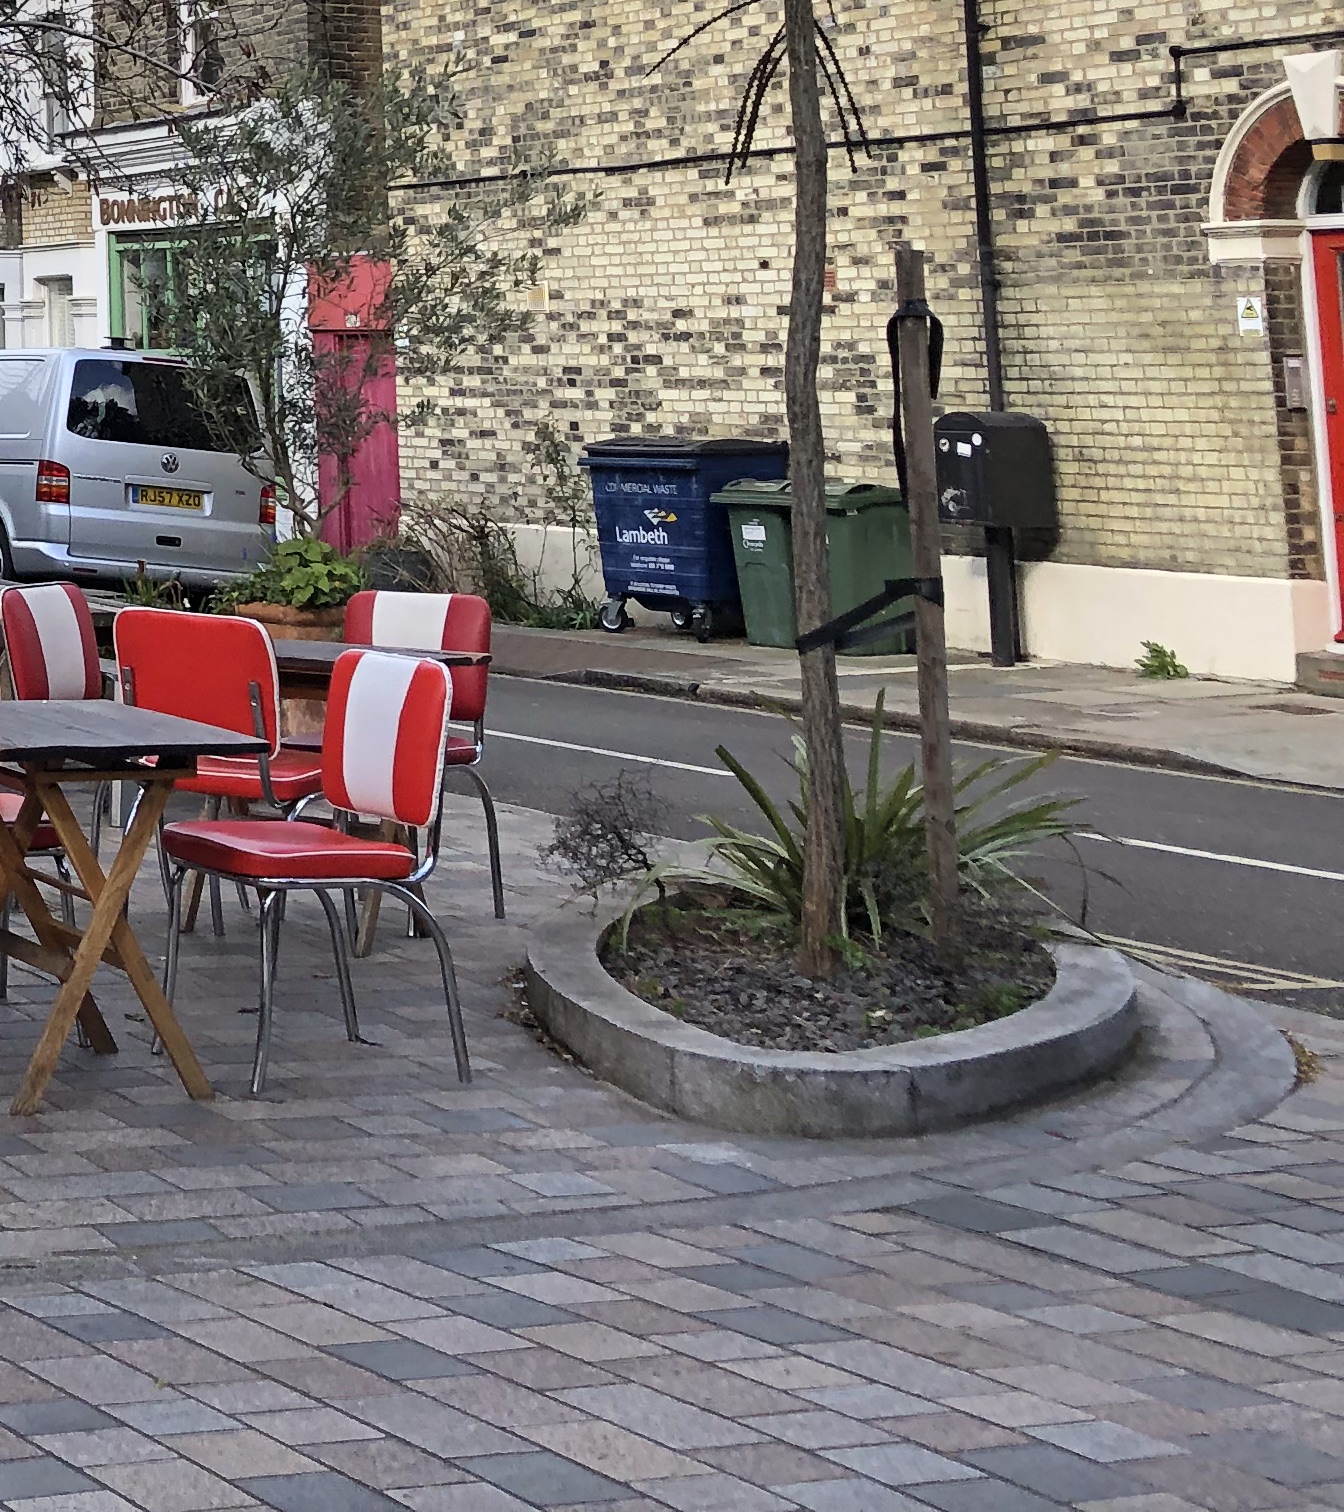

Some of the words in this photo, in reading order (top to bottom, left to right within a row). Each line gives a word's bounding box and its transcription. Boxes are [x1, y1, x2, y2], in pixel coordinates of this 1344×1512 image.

[140, 488, 174, 504] RJ57
[605, 482, 652, 494] COMERCIAL
[615, 526, 669, 545] Lambeth
